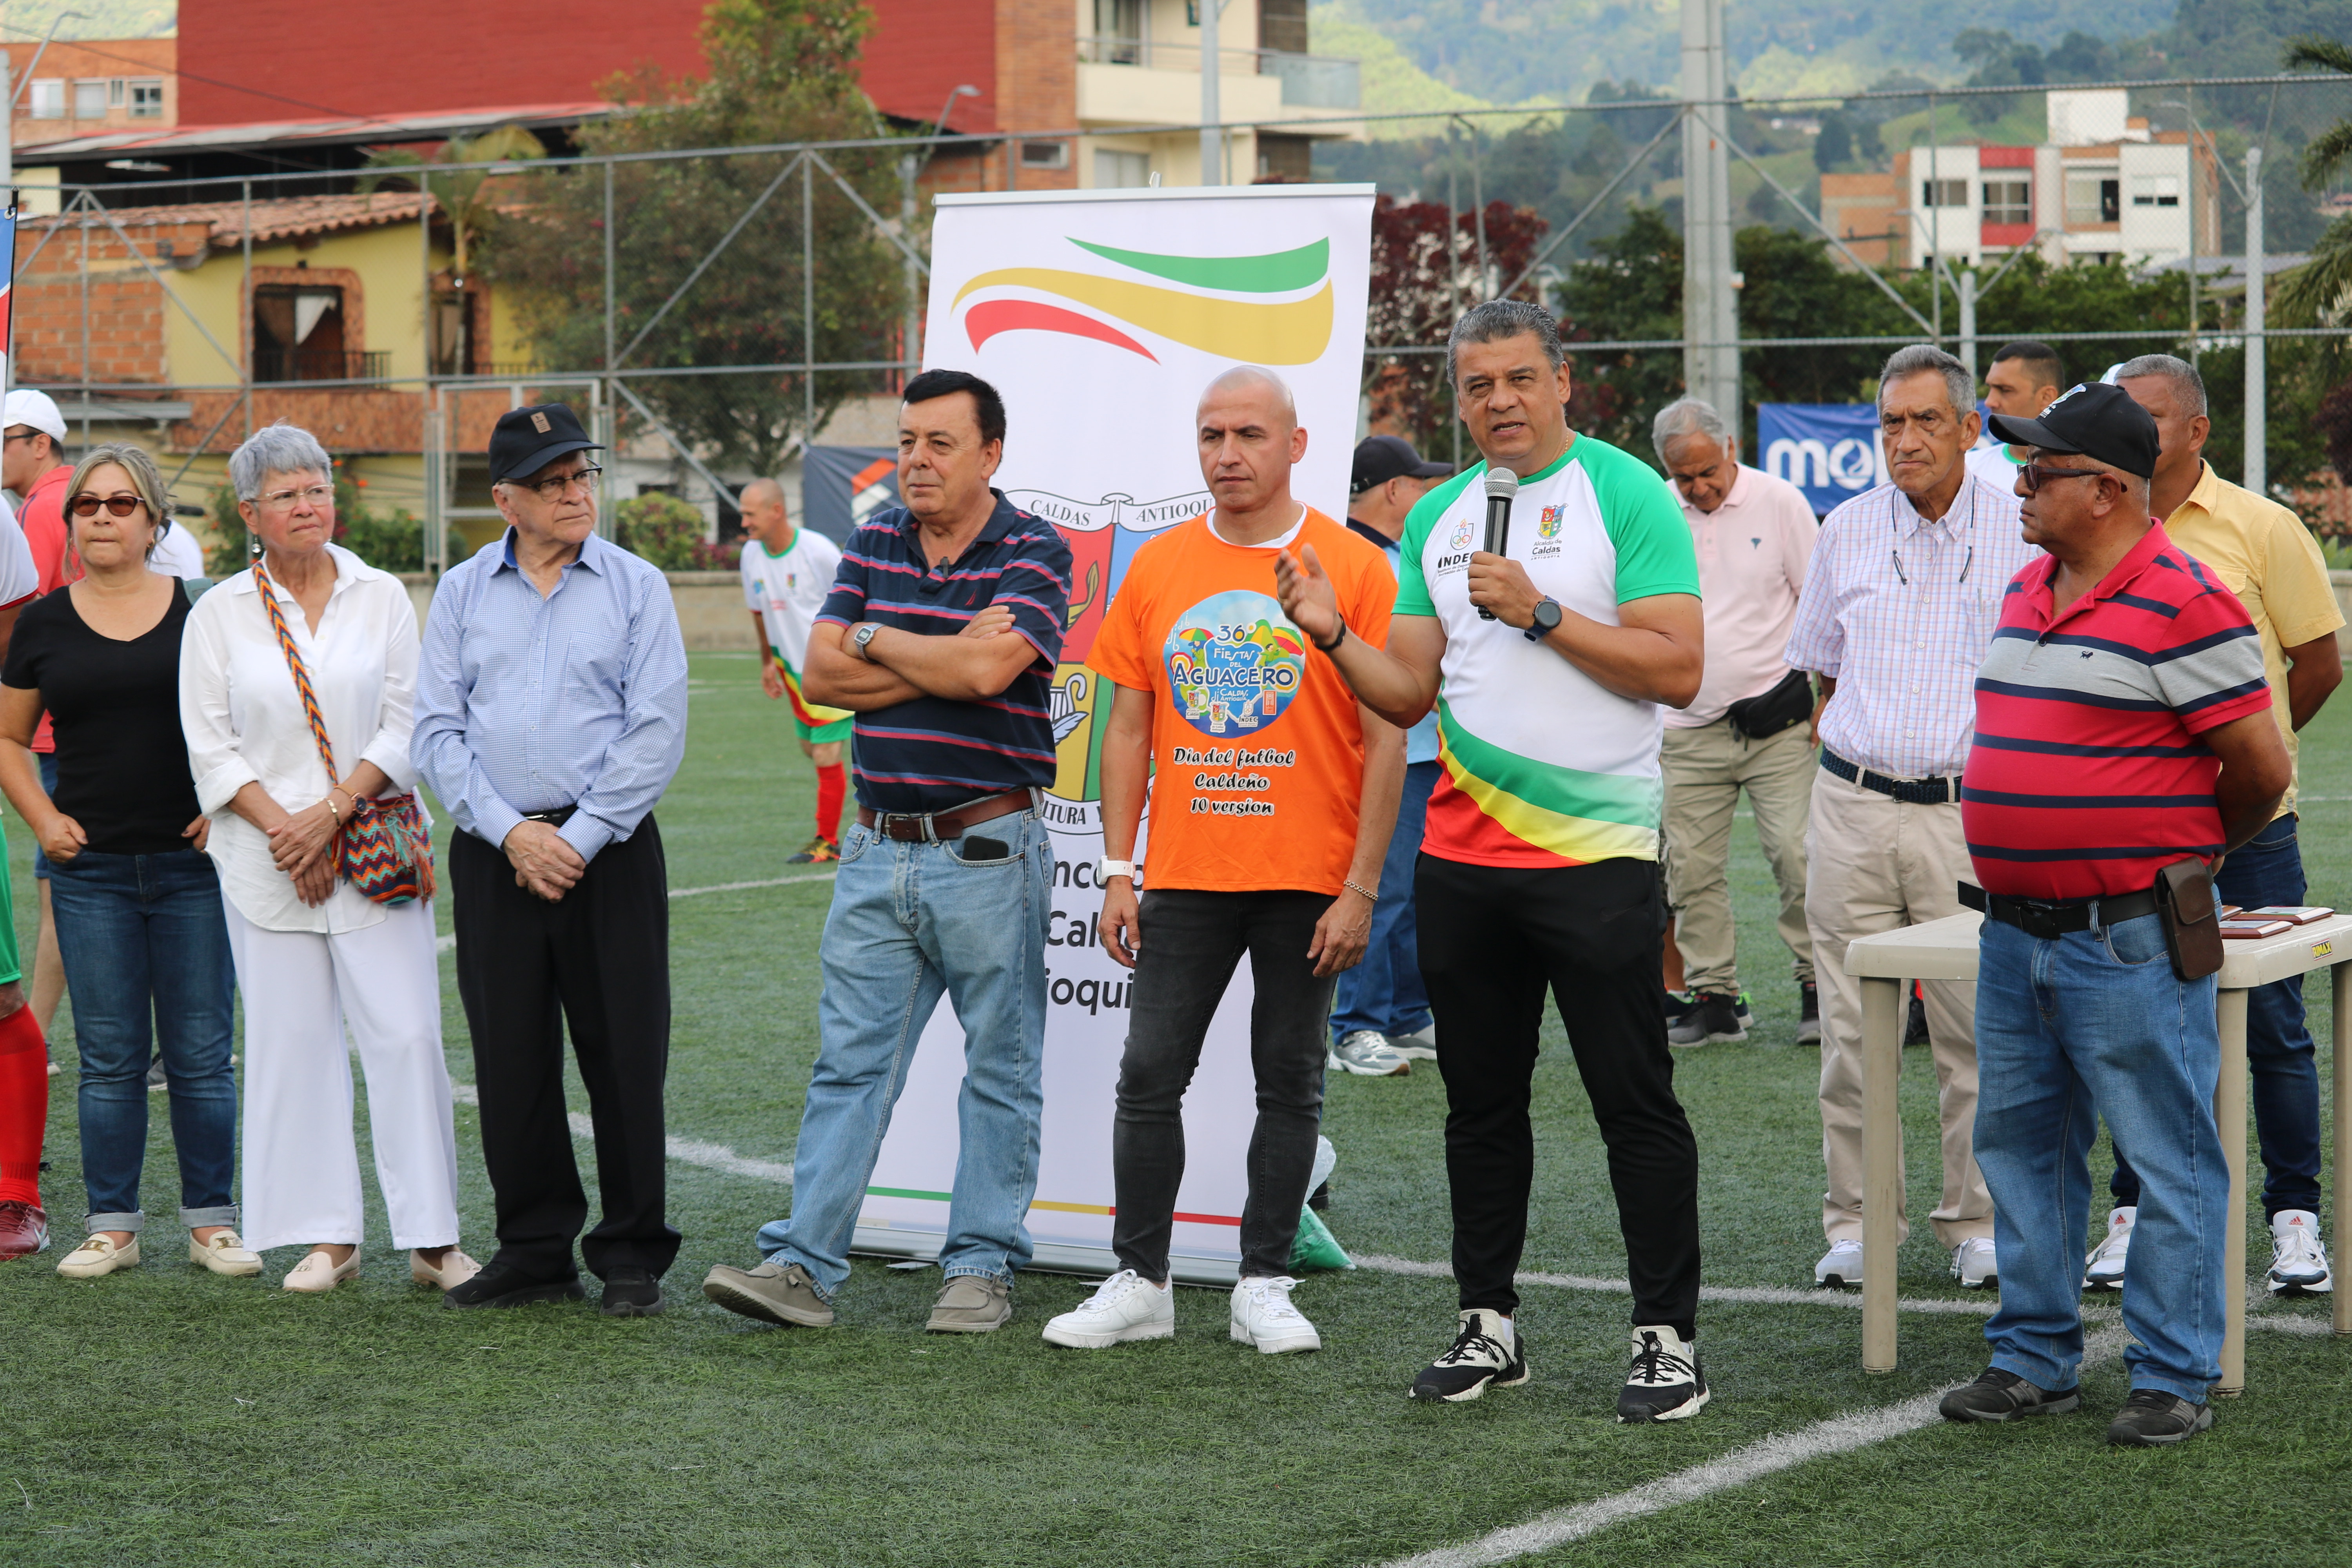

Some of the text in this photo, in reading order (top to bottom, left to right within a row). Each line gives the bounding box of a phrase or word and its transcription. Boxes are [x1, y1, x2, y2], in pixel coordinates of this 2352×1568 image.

[1030, 499, 1091, 526] CALDAS
[1532, 546, 1561, 555] Caldas
[1437, 552, 1474, 568] INDE
[1173, 662, 1293, 686] AGUACERO
[1204, 748, 1232, 763] del
[1237, 749, 1294, 767] futbol
[1195, 773, 1267, 788] Caldeño
[1191, 798, 1272, 814] 10 version
[2312, 942, 2332, 958] RIMAX
